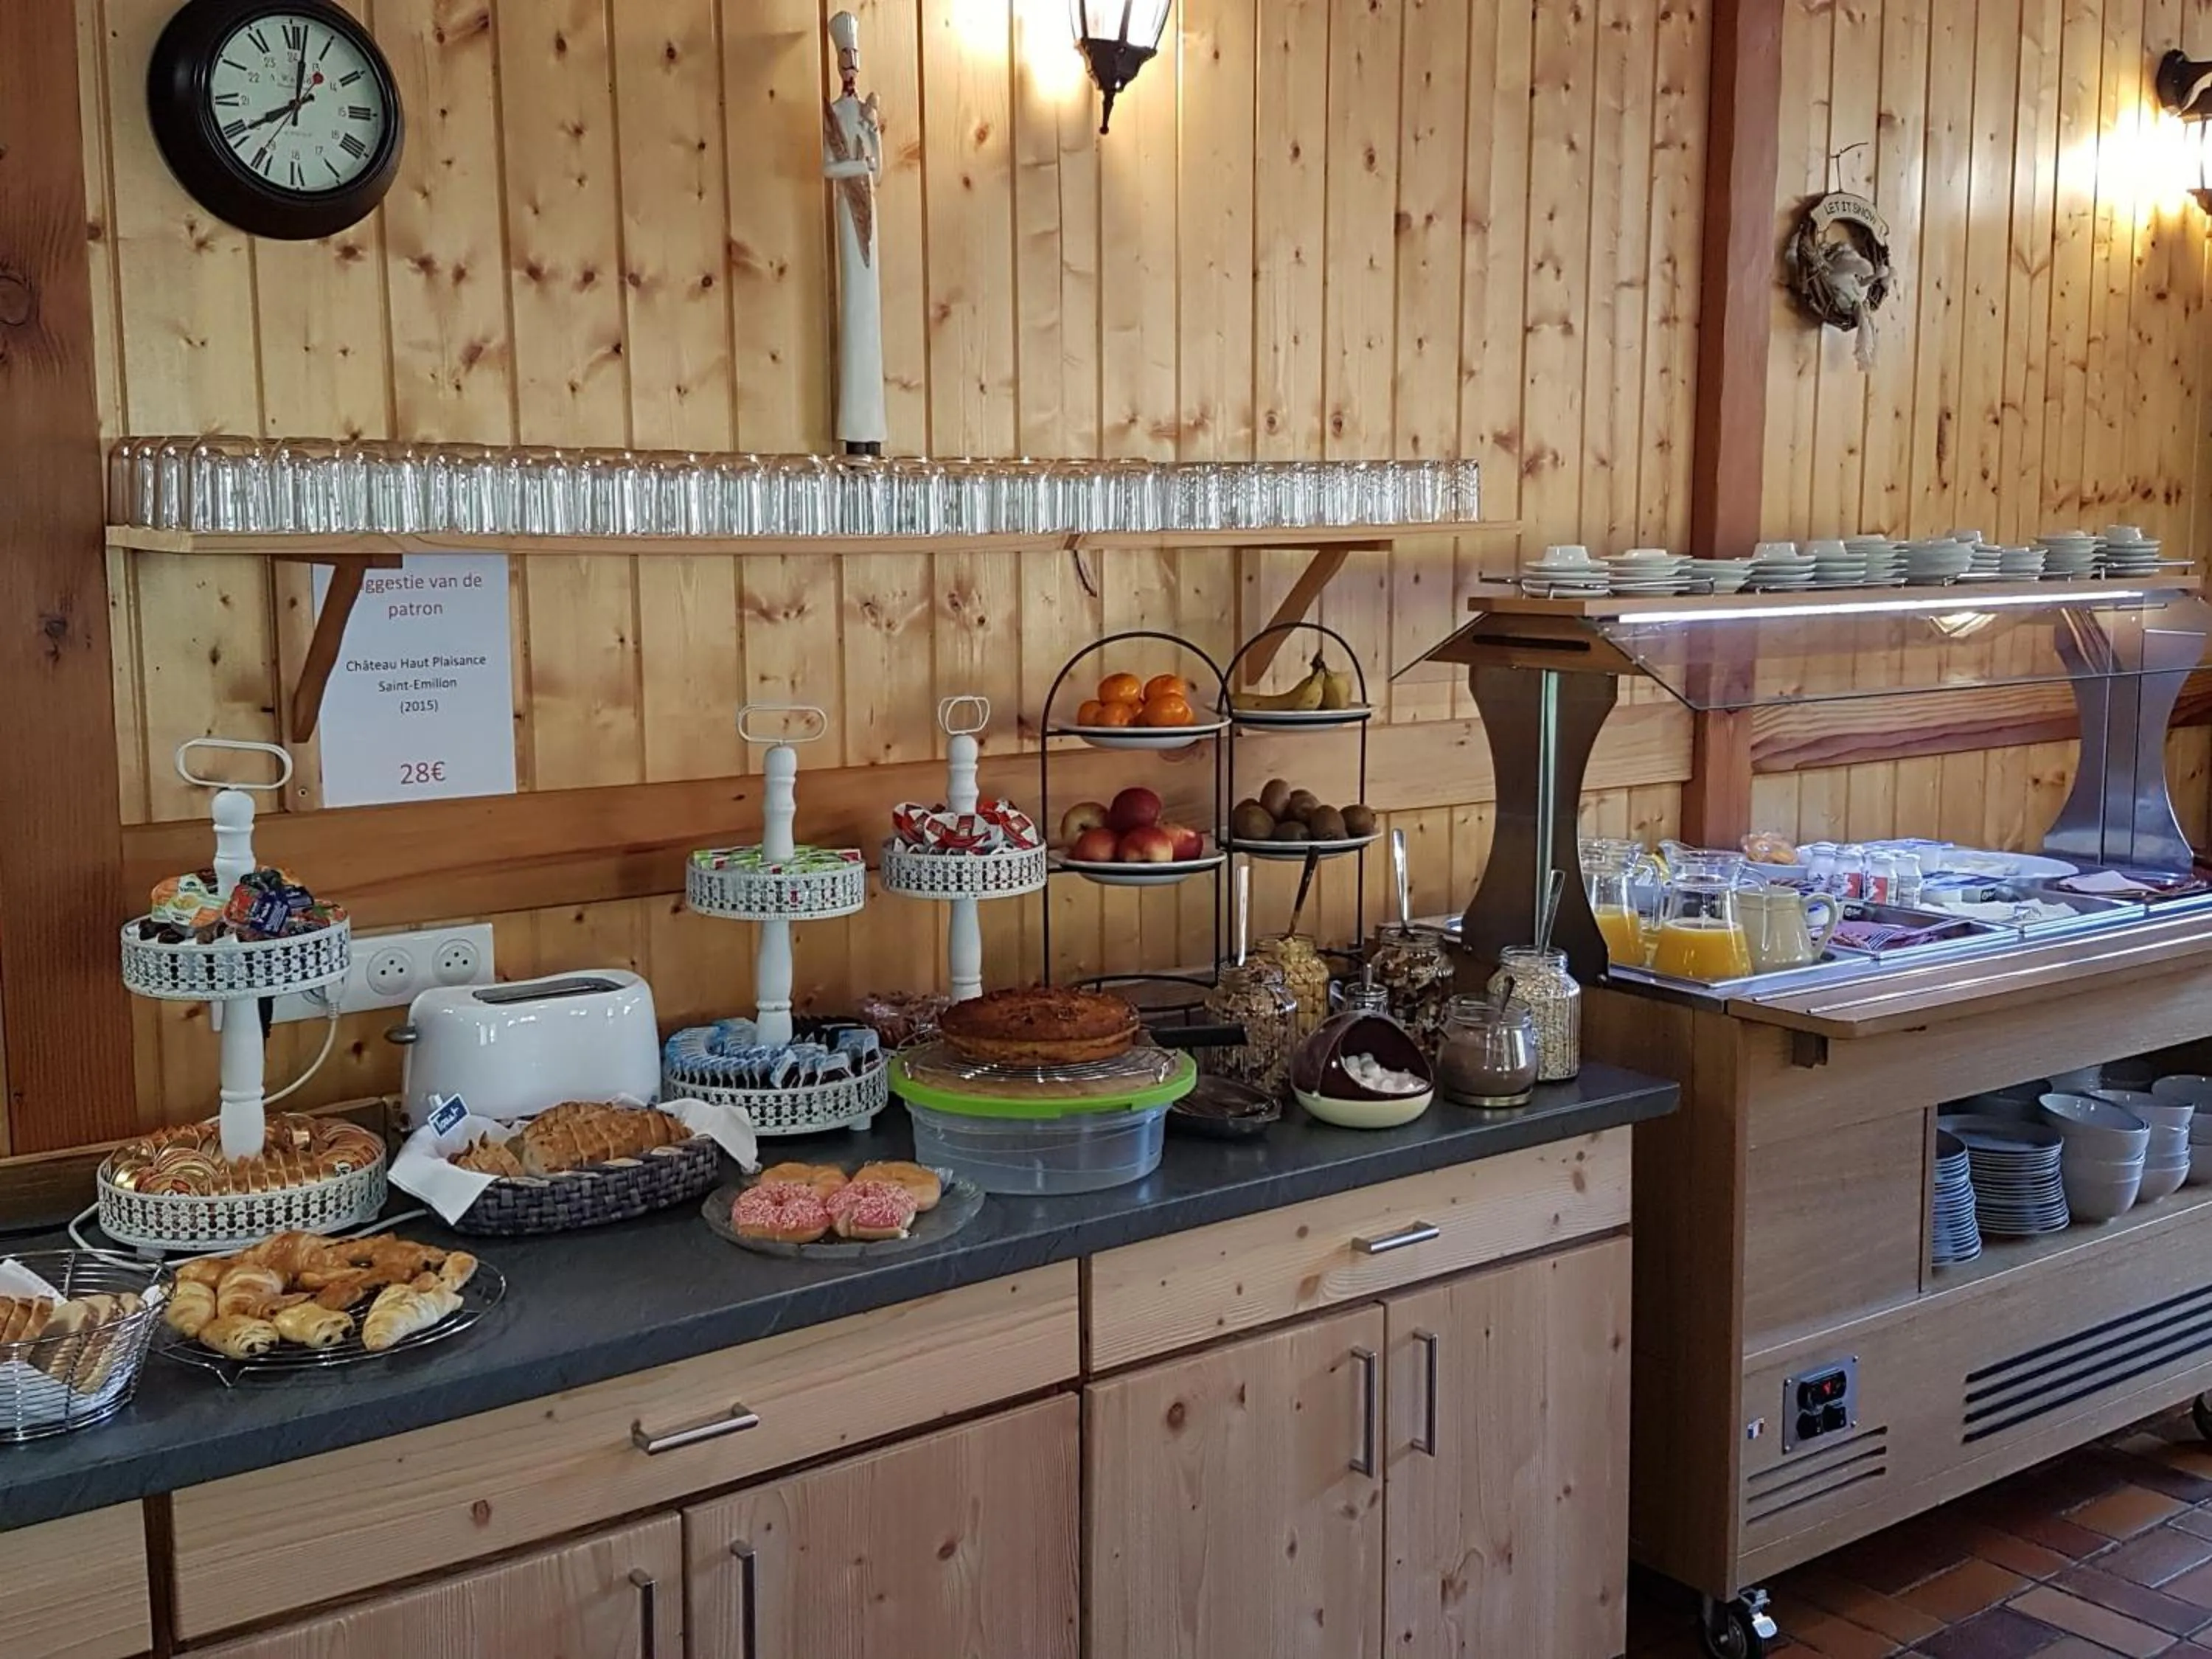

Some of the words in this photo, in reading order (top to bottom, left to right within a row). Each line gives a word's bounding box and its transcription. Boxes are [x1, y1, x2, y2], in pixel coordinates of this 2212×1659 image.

[248, 72, 260, 84] 22
[362, 574, 425, 594] ggestie
[429, 577, 459, 589] van
[462, 571, 483, 588] de
[388, 602, 443, 619] patron
[345, 659, 397, 672] Château
[400, 658, 430, 669] Haut
[432, 655, 487, 667] Plaisance
[378, 678, 458, 693] Saint-Emilion
[400, 699, 439, 714] (2015)
[400, 760, 447, 785] 28€
